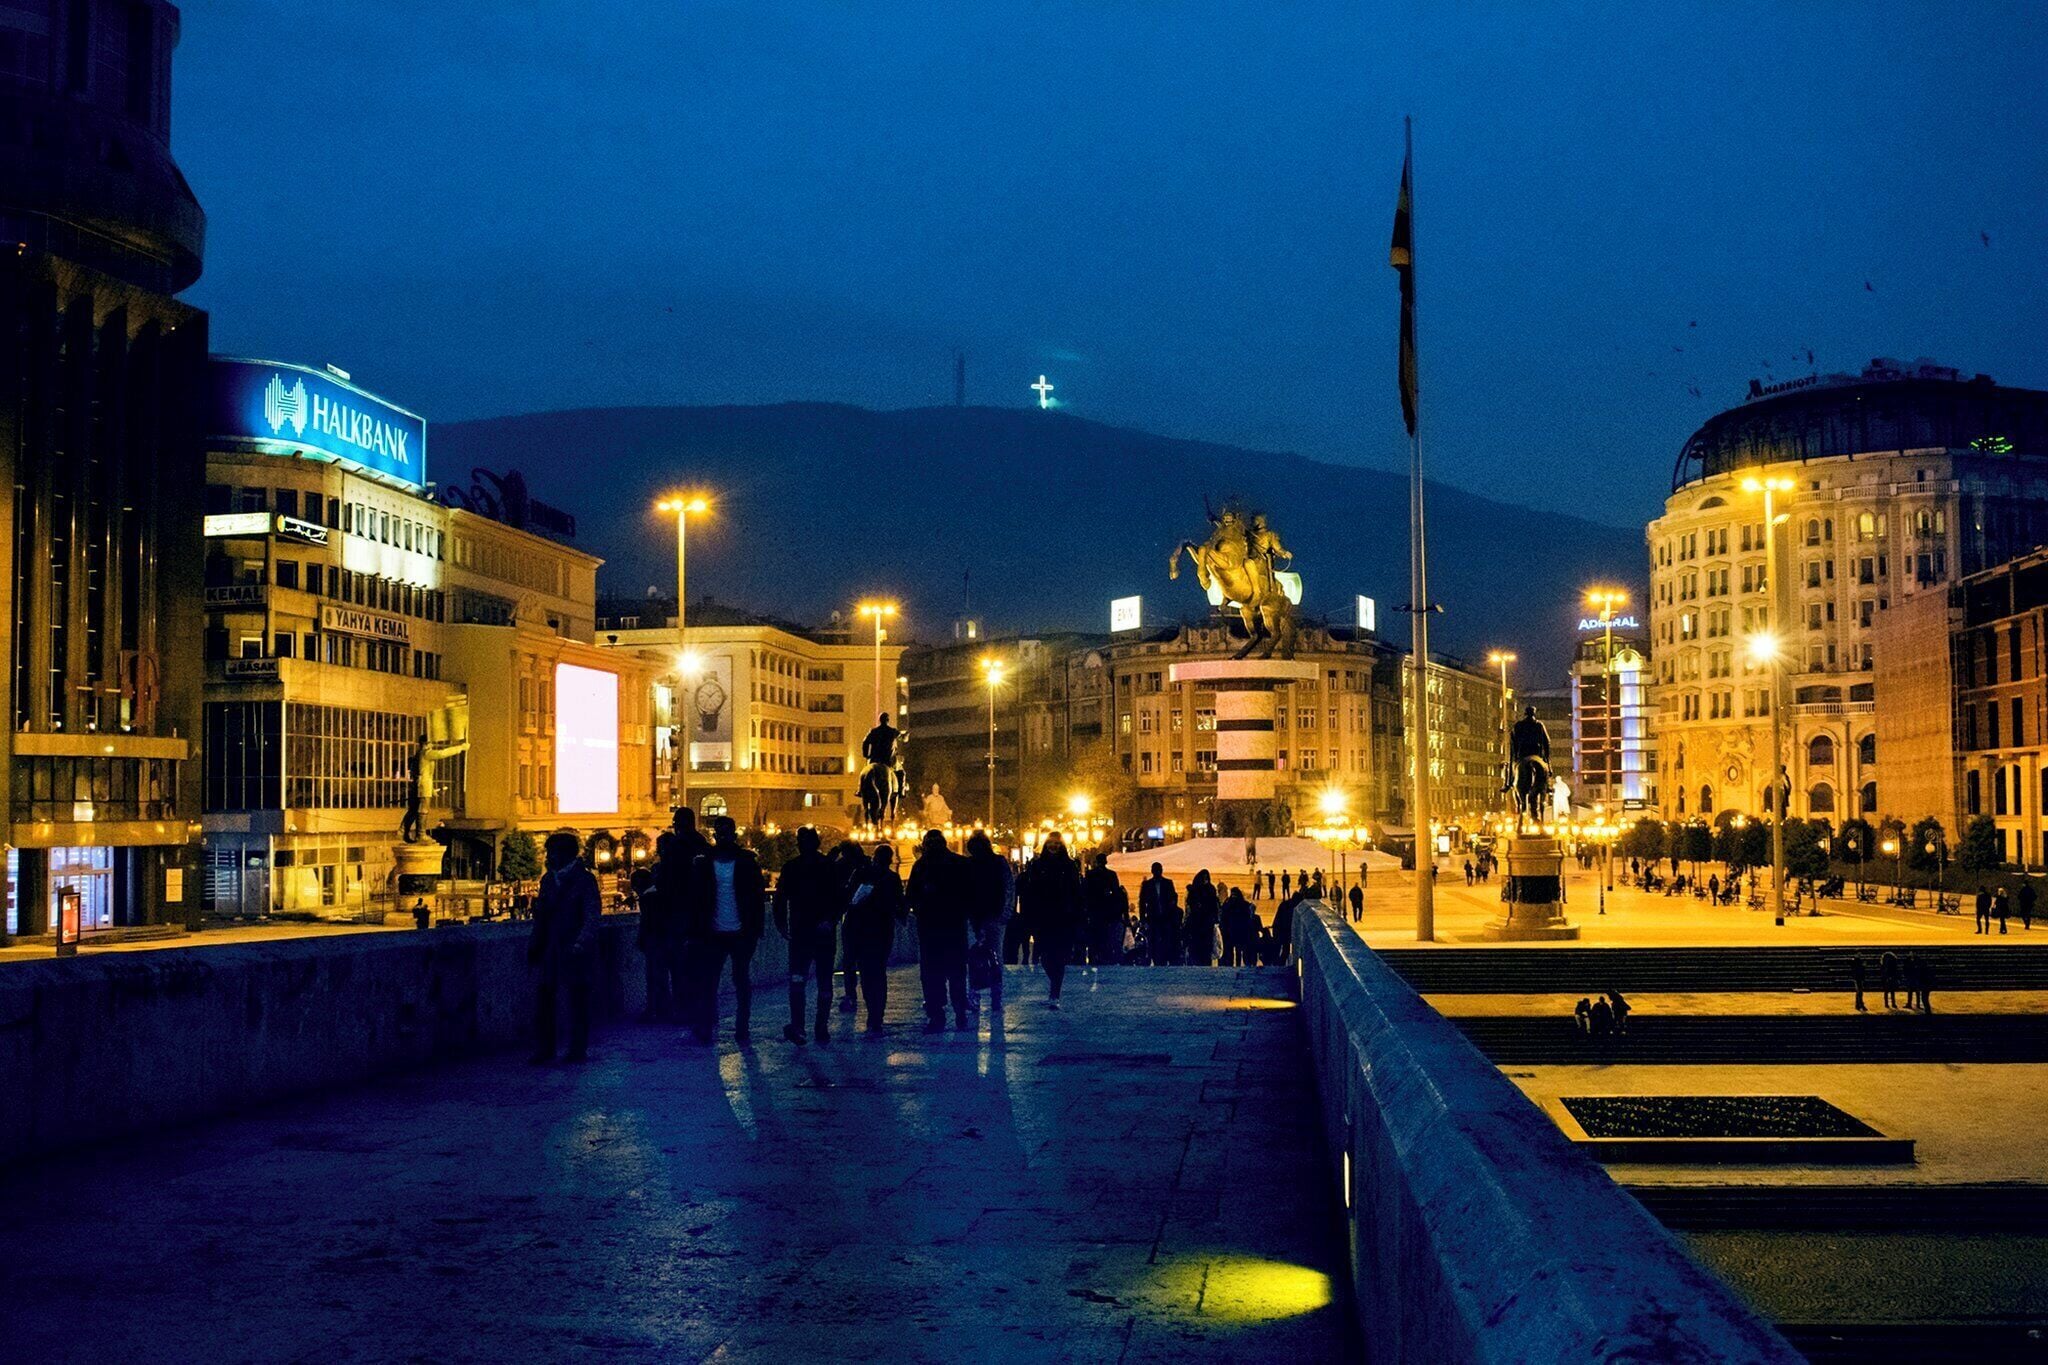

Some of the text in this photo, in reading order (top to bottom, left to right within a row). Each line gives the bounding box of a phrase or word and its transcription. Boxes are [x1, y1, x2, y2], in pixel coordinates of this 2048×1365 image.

[313, 393, 409, 465] HALKBANK
[205, 586, 263, 601] KEMAL
[336, 609, 409, 638] YAHYA KEMAL
